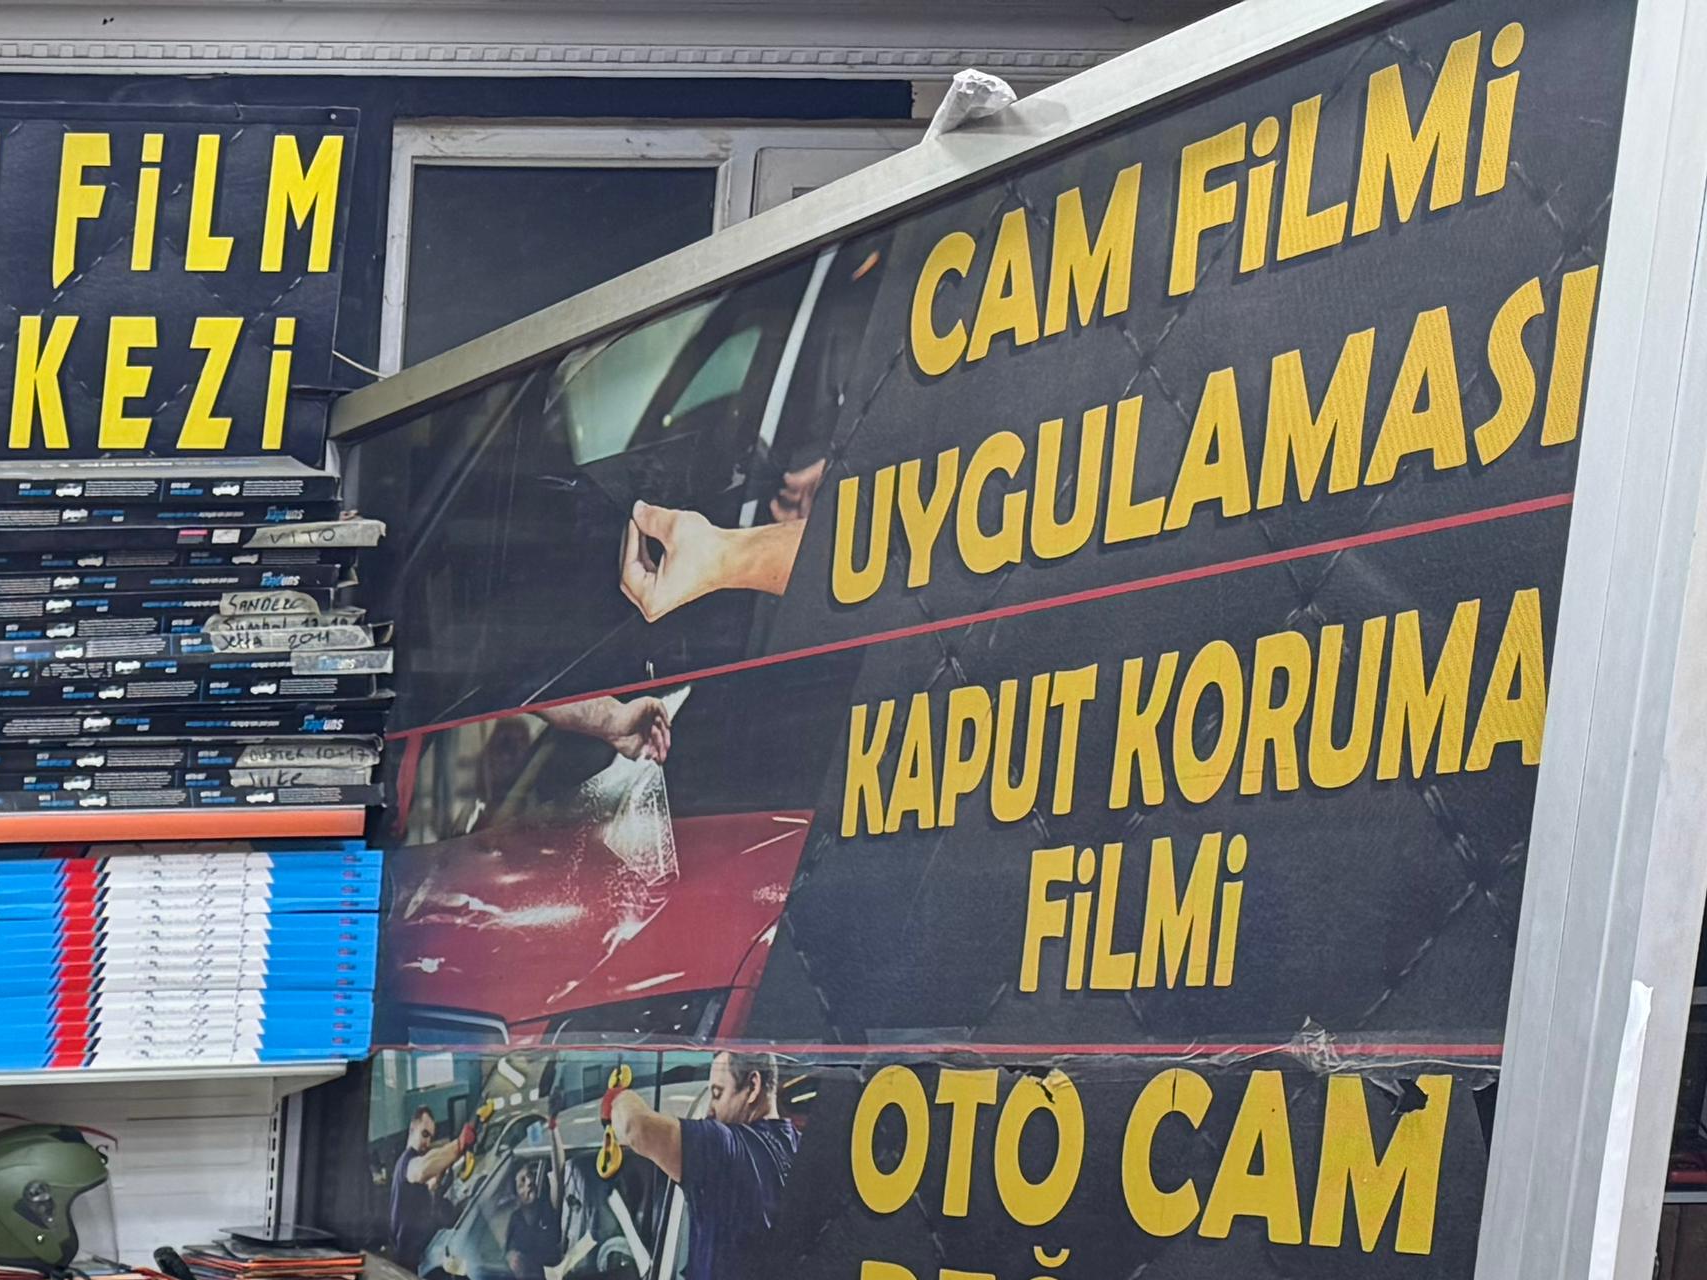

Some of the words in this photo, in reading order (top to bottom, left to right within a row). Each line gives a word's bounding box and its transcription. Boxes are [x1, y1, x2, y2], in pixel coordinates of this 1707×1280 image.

[910, 163, 1142, 376] CAM
[269, 528, 336, 545] VITO
[832, 264, 1599, 604] UYGULAMASI
[840, 663, 1098, 838] KAPUT
[1108, 587, 1547, 809] KORUMA
[849, 1065, 1085, 1227] OTO
[1122, 1068, 1453, 1255] CAM
